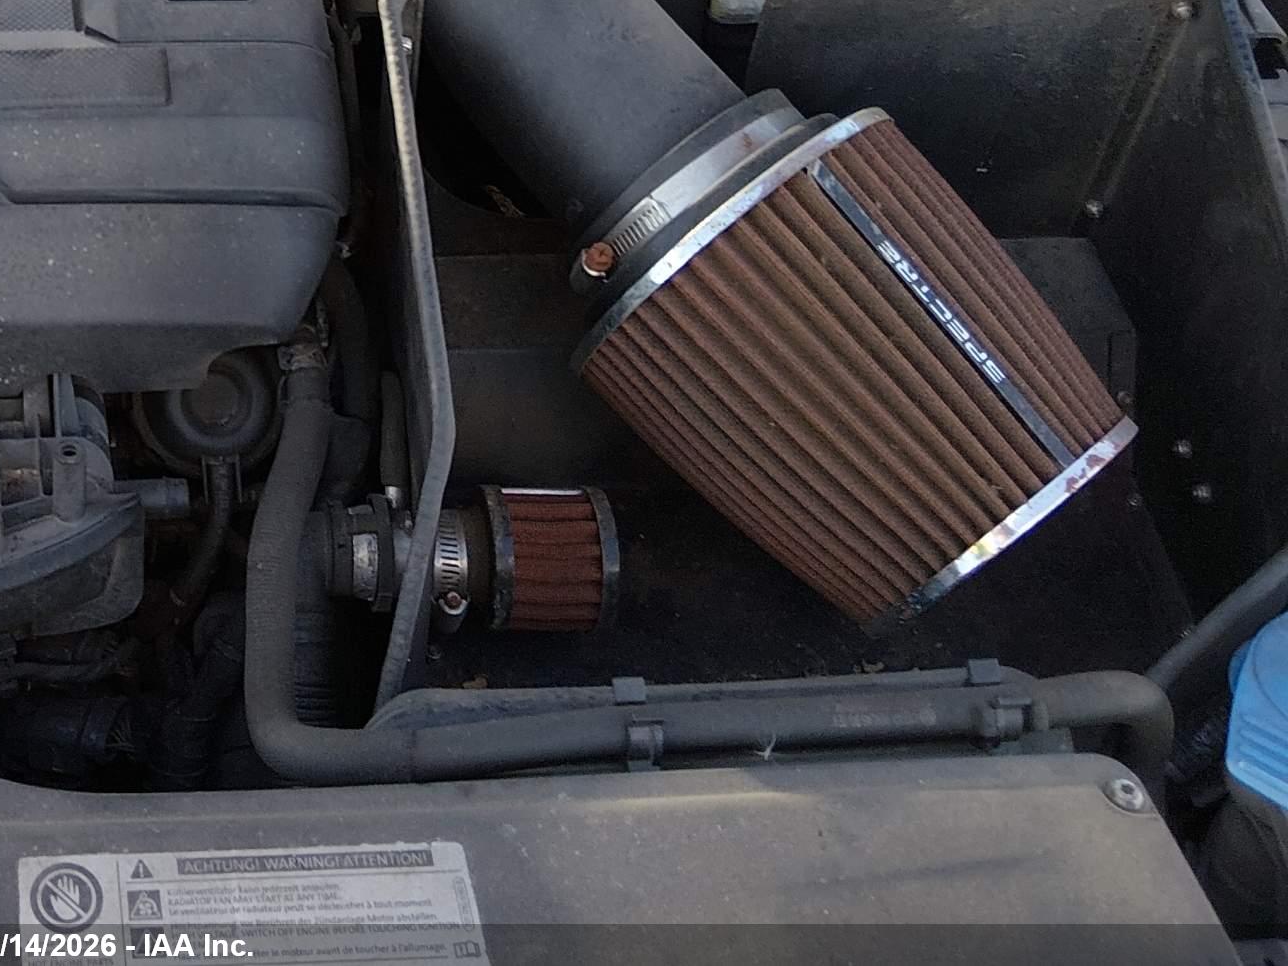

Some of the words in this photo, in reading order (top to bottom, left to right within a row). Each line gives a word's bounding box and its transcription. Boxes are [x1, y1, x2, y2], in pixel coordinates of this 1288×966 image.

[878, 240, 1006, 384] SPECTRE
[184, 857, 260, 872] ACHTUNG!
[264, 853, 339, 868] WARNING!
[341, 849, 428, 867] ATTENTION!
